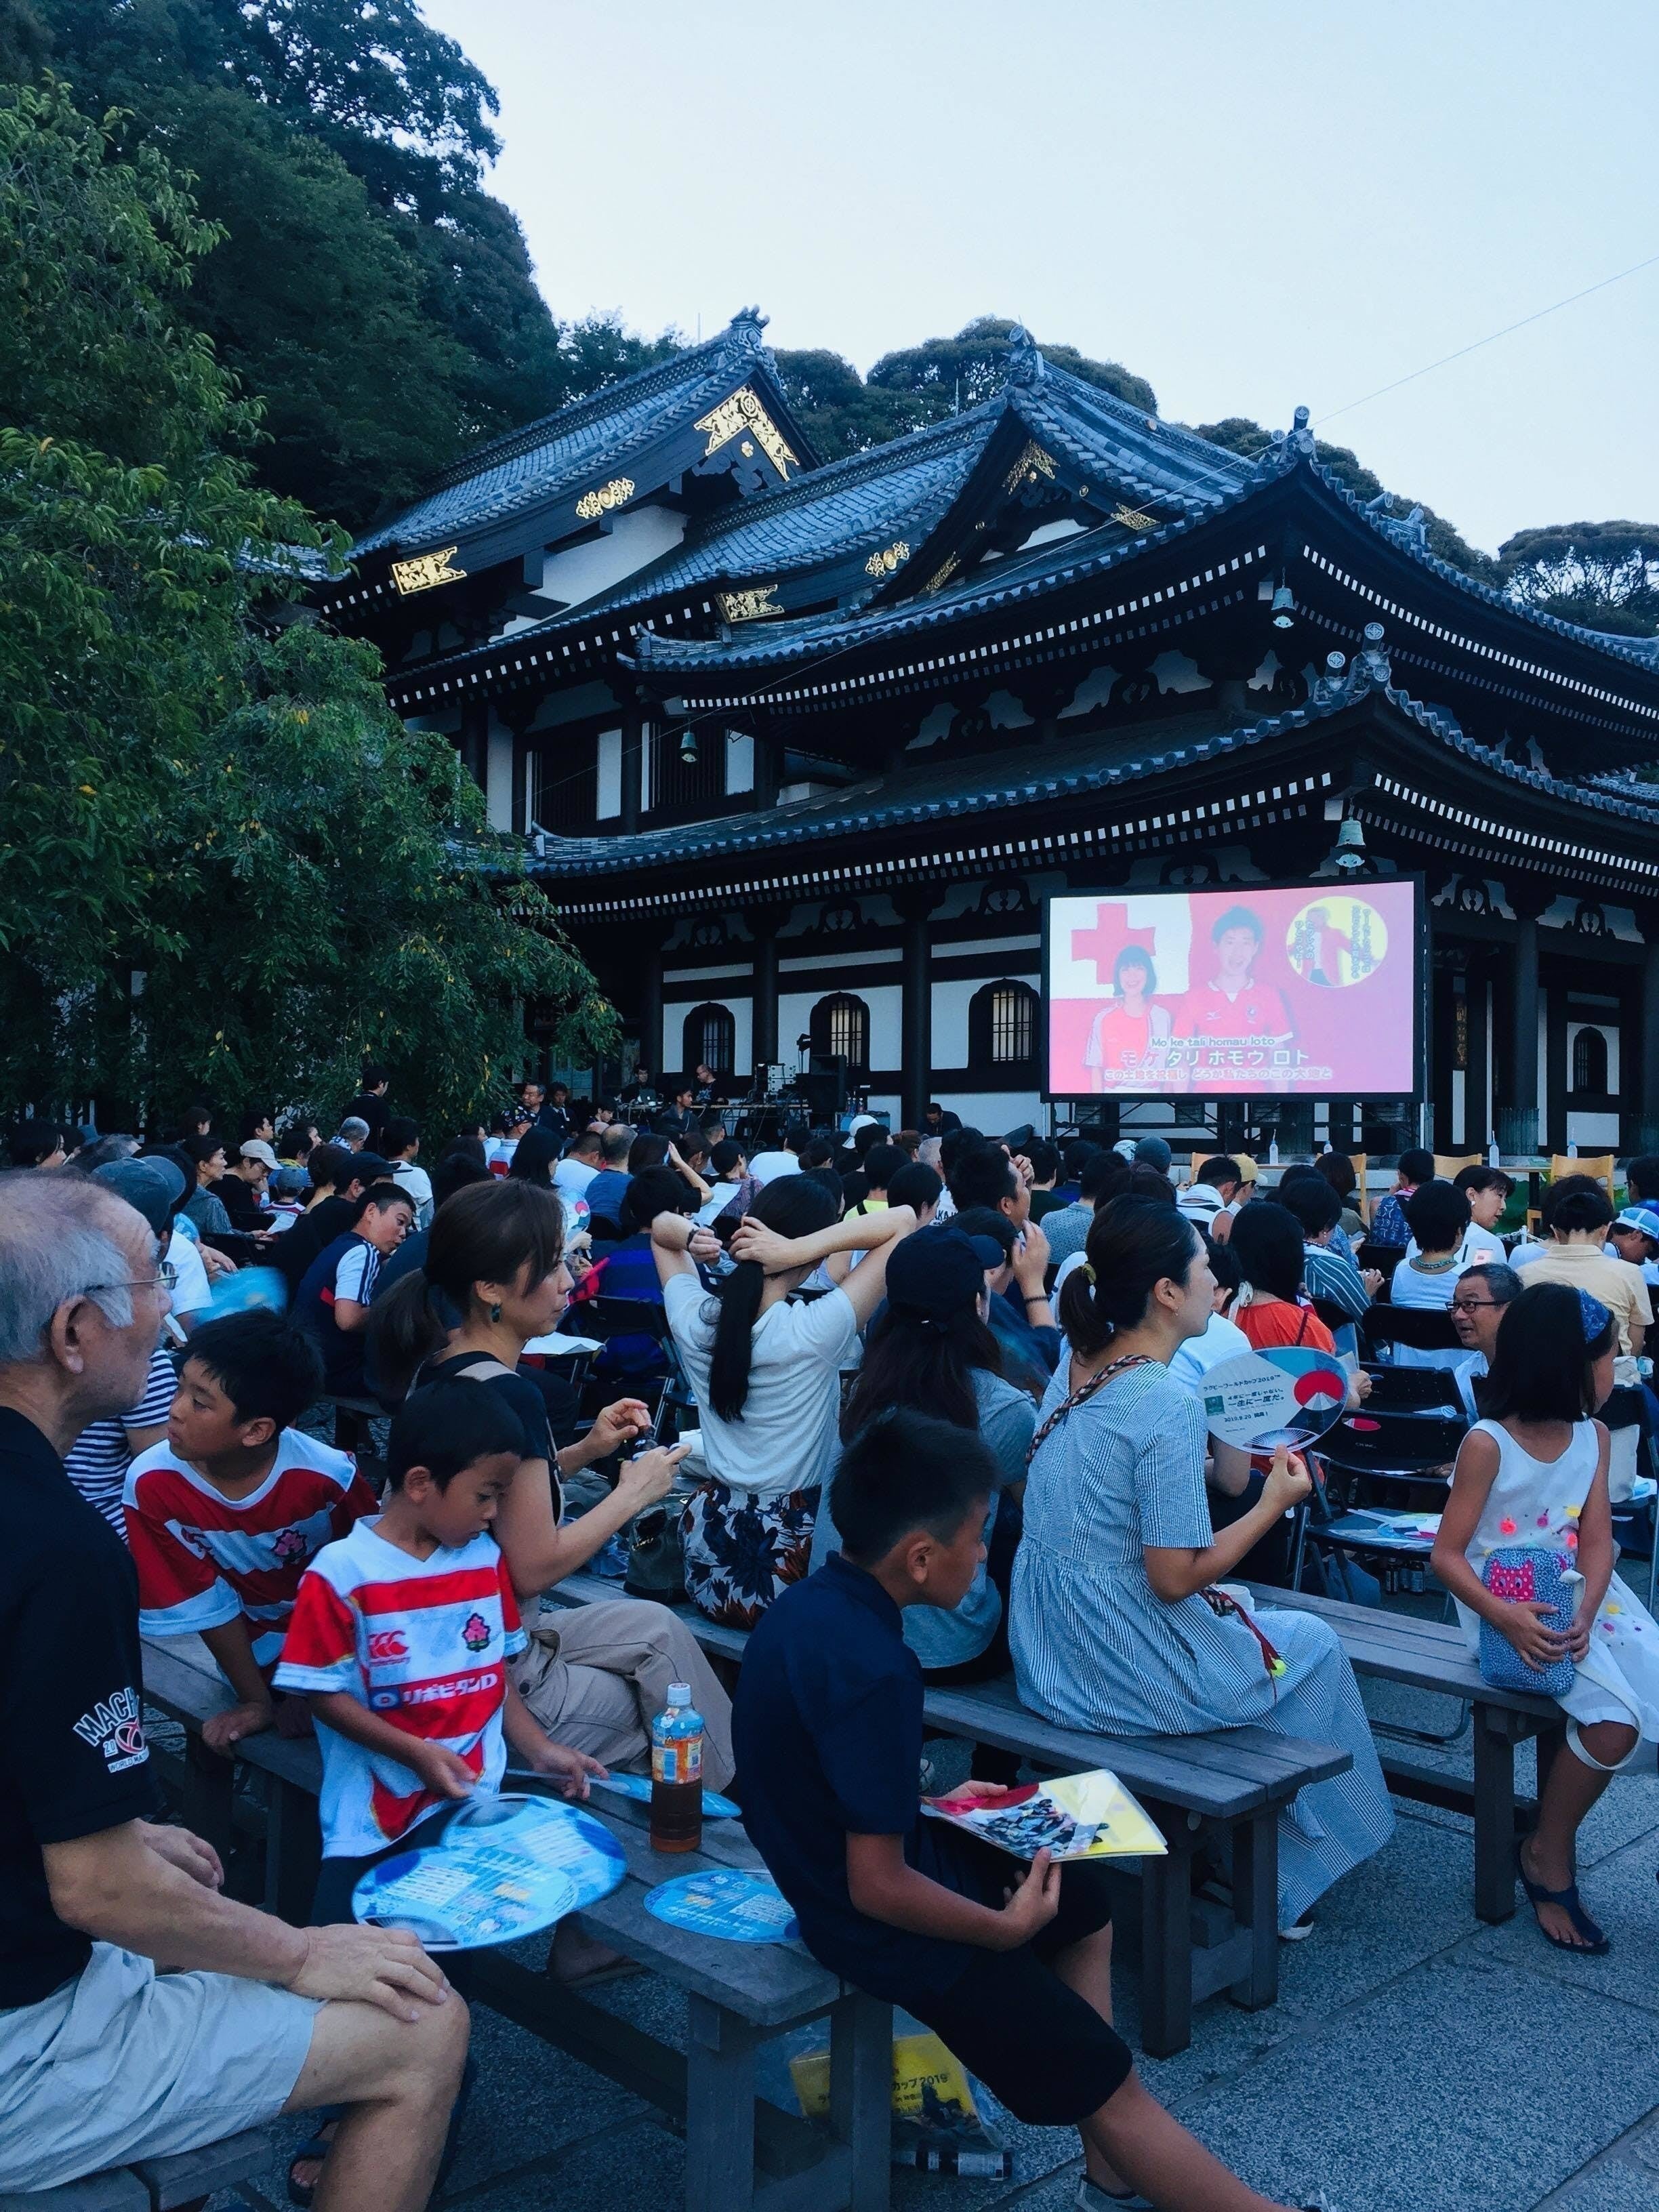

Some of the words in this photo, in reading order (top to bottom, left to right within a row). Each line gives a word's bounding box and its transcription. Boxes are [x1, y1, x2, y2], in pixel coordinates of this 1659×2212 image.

[1151, 1037, 1167, 1047] Mo
[1170, 1037, 1184, 1047] ke
[1209, 1036, 1247, 1046] homau
[1250, 1036, 1275, 1046] loto
[1120, 1050, 1137, 1068] モ
[1167, 1050, 1200, 1067] タリ
[1208, 1050, 1264, 1066] ホモウ
[1273, 1049, 1309, 1066] ロト
[109, 1757, 134, 1771] WORLD
